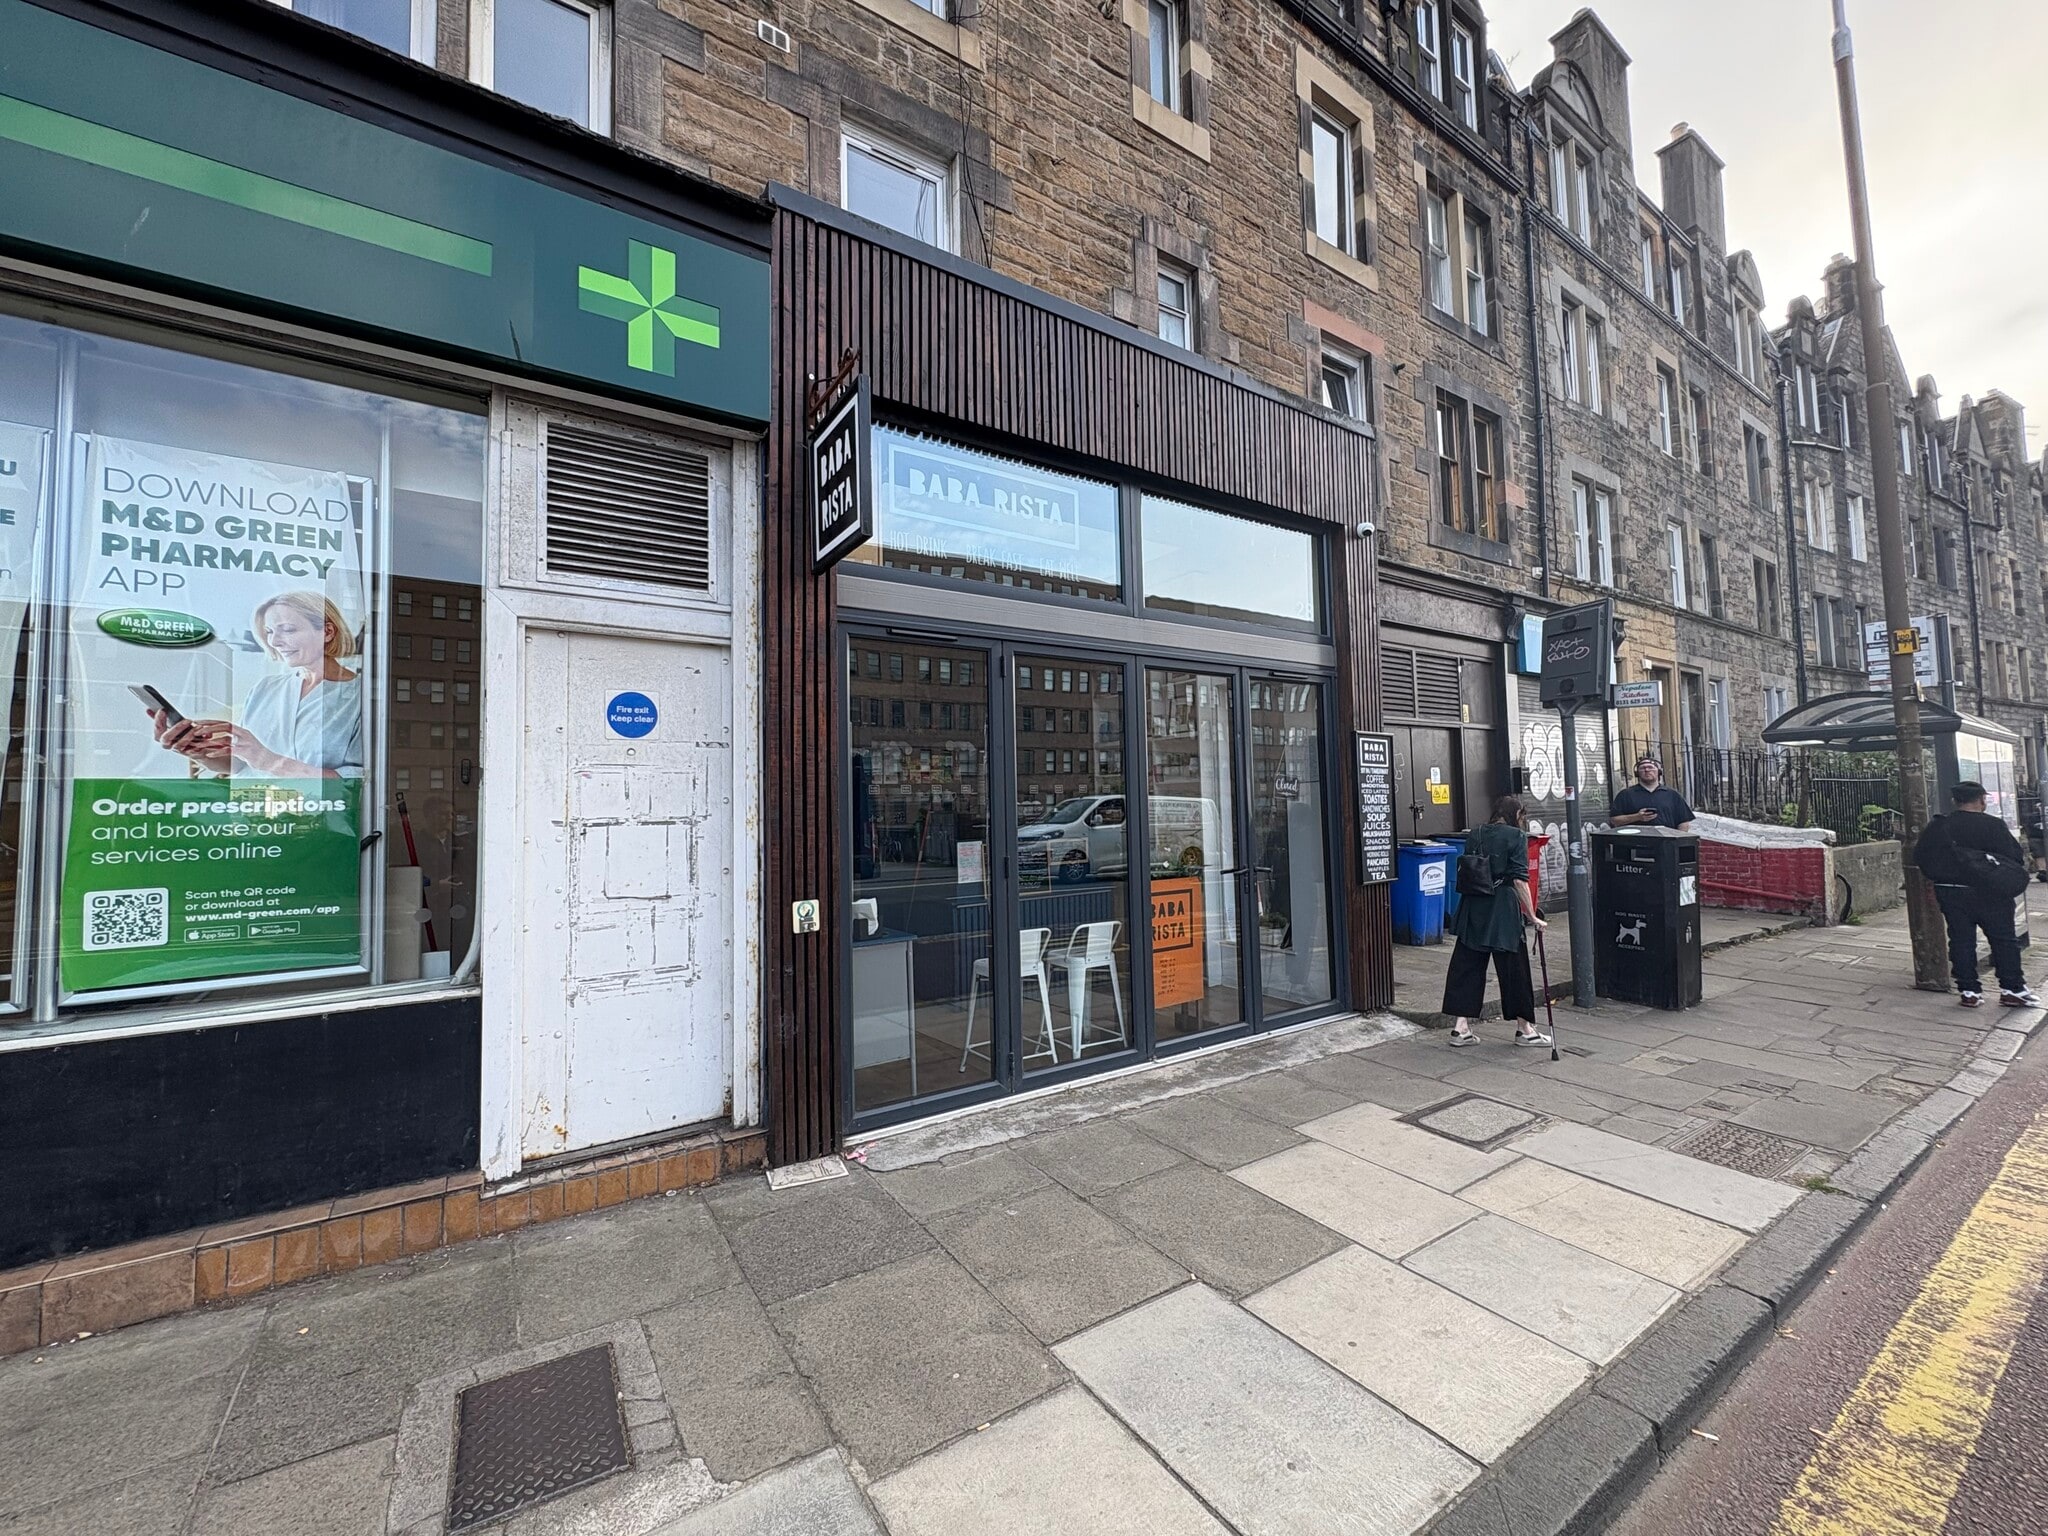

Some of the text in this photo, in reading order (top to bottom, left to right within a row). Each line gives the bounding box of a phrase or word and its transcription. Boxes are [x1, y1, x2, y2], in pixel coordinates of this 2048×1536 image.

[820, 428, 852, 488] BABA
[104, 467, 348, 522] DOWNLOAD
[910, 468, 1064, 526] BABA RISTA
[821, 477, 852, 532] RISTA
[102, 499, 342, 552] M&D GREEN
[101, 532, 336, 580] PHARMACY
[890, 530, 910, 552] HOT
[916, 534, 948, 560] DRINK
[966, 544, 996, 568] BREAK
[1001, 550, 1024, 572] FAST
[99, 566, 186, 596] APP
[120, 616, 194, 633] M&D GREEN
[131, 628, 184, 638] PHARMACY
[616, 706, 649, 714] Fire exit
[611, 714, 632, 724] Keep
[1364, 742, 1384, 752] BABA
[1364, 753, 1384, 762] RISTA
[1366, 774, 1384, 784] COFFEE
[1364, 794, 1388, 804] TOASTIES
[92, 796, 346, 818] Order prescriptions
[1362, 804, 1390, 813] SANDWICHES
[1367, 814, 1386, 822] SOUP
[92, 820, 296, 840] and browse our
[1363, 822, 1390, 830] JUICES
[1363, 830, 1391, 838] MILKSHAKES
[91, 842, 282, 865] services online
[1366, 858, 1390, 866] PANCAKES
[1616, 864, 1644, 874] Litter
[1371, 872, 1387, 880] TEA
[185, 886, 296, 900] Scan the QR code
[202, 900, 264, 910] download
[266, 898, 280, 906] at
[185, 904, 340, 922] www.md-green.com/app
[202, 932, 216, 940] App
[217, 930, 236, 938] Store
[262, 928, 283, 936] Google
